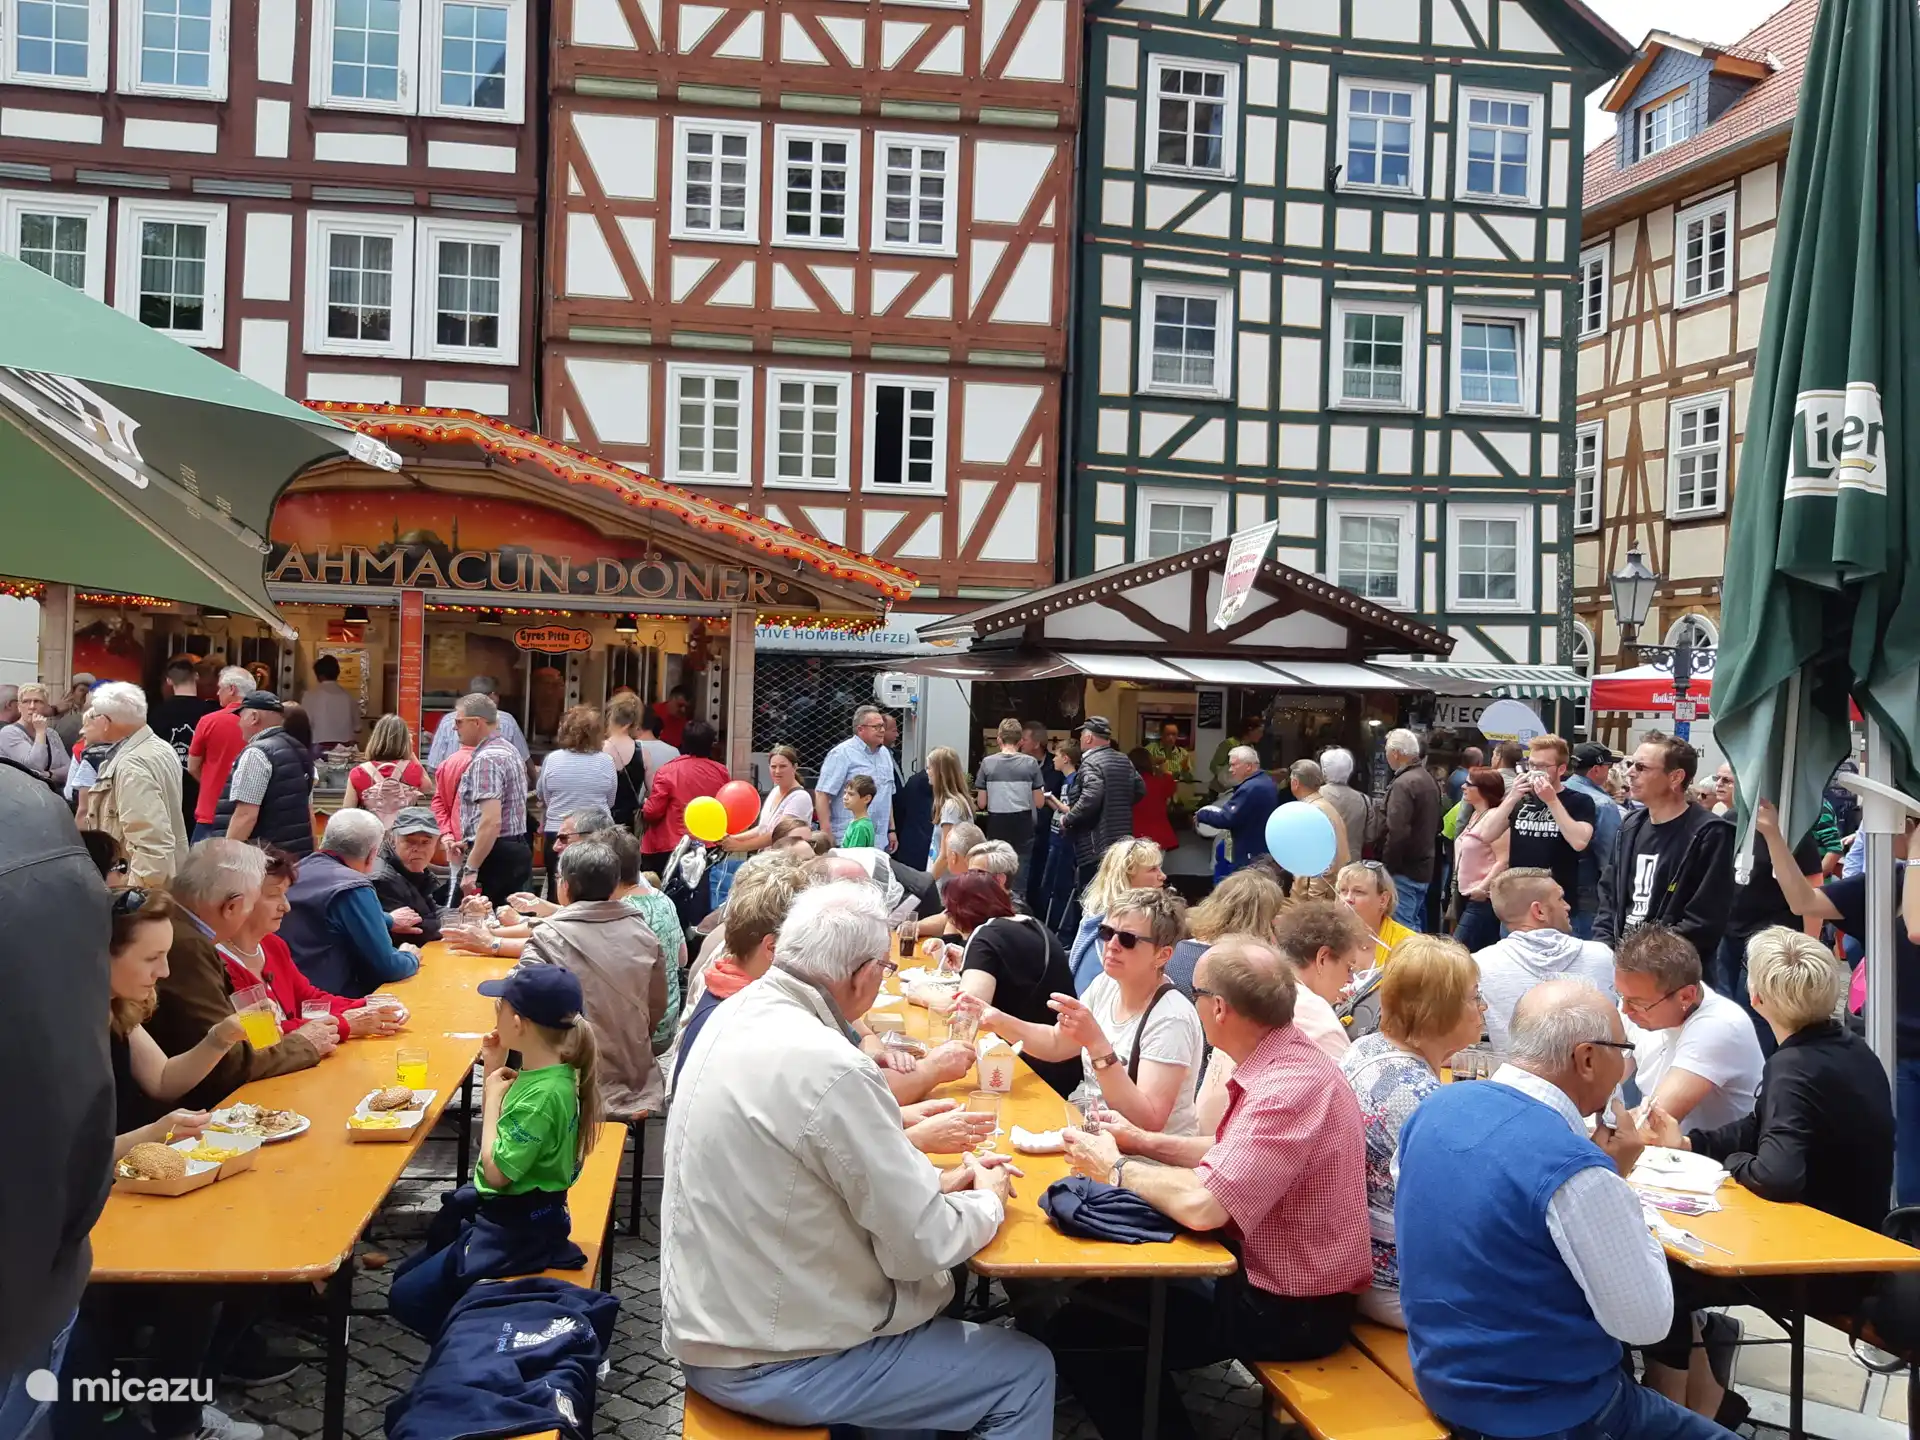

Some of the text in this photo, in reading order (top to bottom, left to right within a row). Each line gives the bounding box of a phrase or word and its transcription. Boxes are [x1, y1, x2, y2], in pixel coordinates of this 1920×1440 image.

[265, 542, 777, 604] AHMACUN DÖNER
[520, 630, 546, 642] Gyros
[548, 631, 570, 641] Pitta
[795, 629, 865, 642] HOMBERG
[870, 633, 910, 645] (EFZE)
